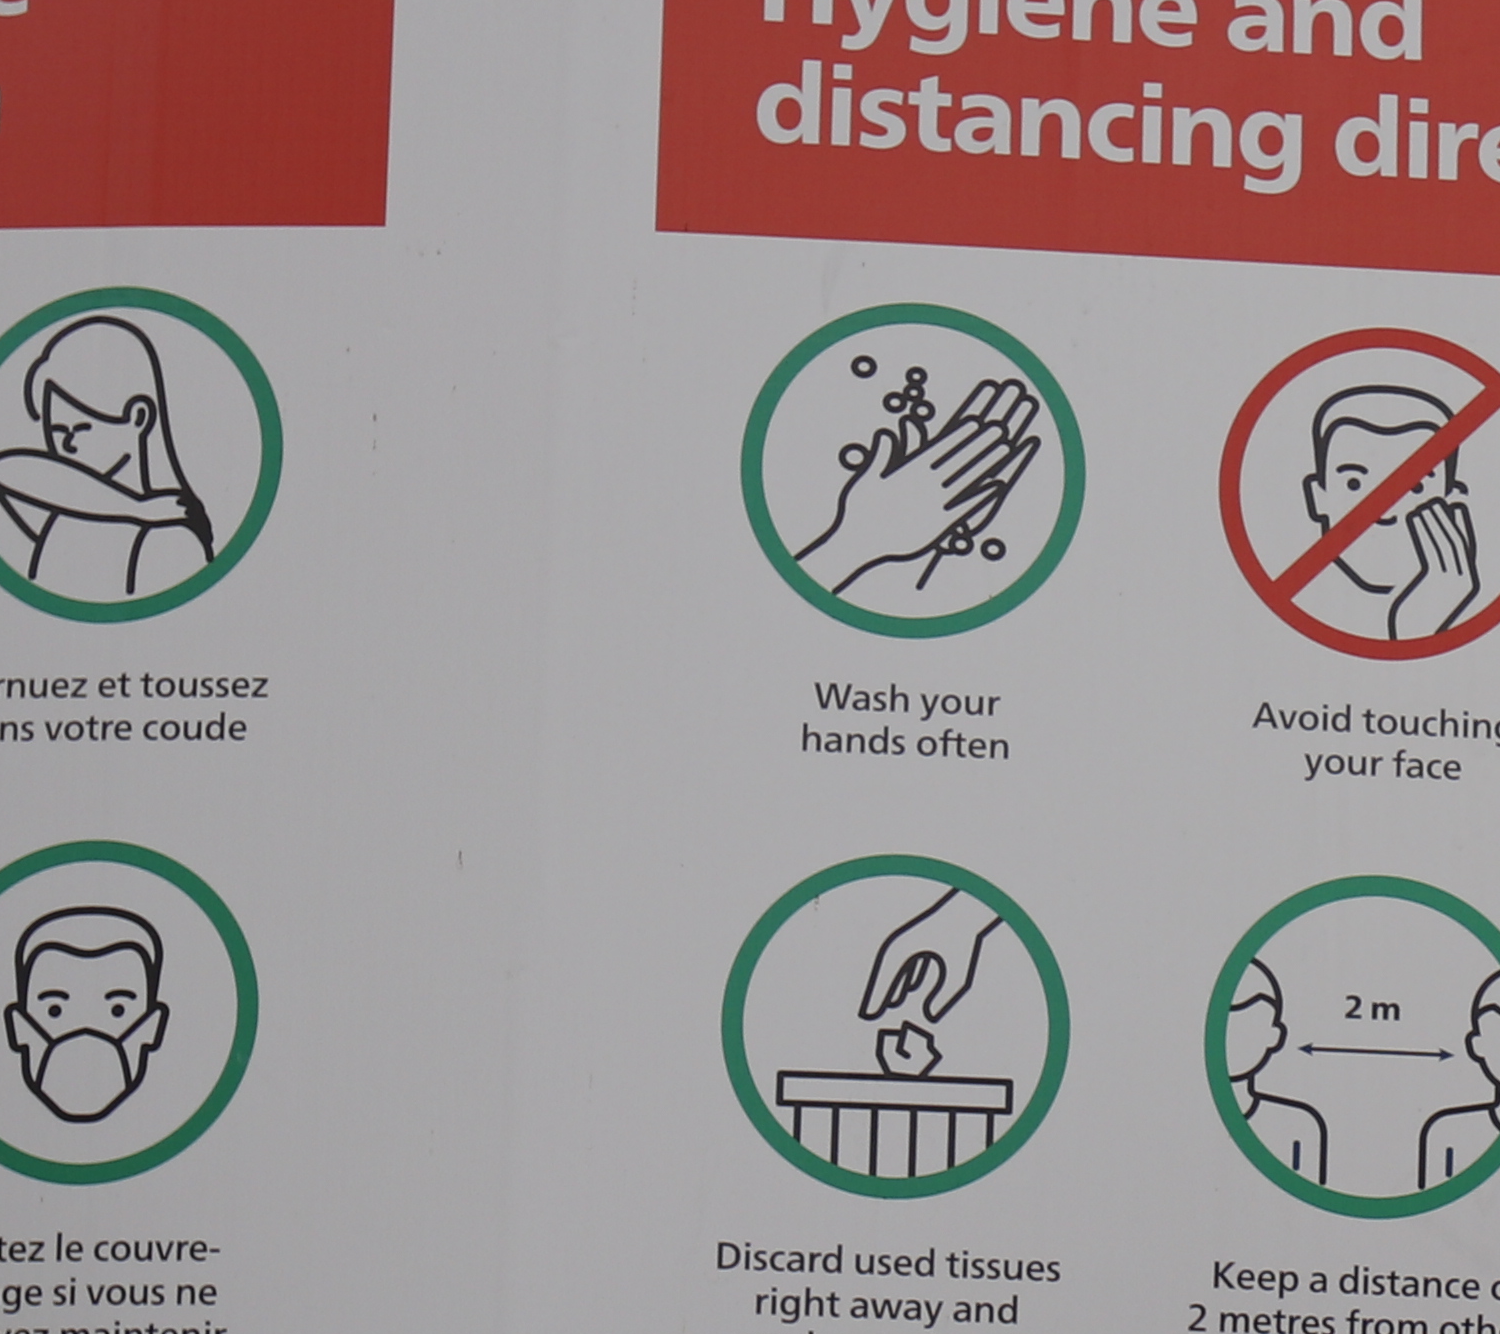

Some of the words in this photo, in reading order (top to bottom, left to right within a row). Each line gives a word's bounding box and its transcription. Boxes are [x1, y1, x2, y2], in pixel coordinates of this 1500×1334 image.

[755, 58, 1304, 196] distancing
[97, 672, 132, 699] et
[139, 672, 269, 699] toussez
[813, 681, 910, 714] Wash
[919, 692, 1002, 723] your
[43, 715, 134, 742] votre
[141, 710, 248, 742] coude
[1251, 701, 1352, 734] Avoid
[801, 721, 907, 757] hands
[915, 727, 1010, 761] often
[1303, 752, 1385, 783] your
[1391, 748, 1463, 782] face
[1343, 993, 1363, 1021] 2
[1370, 1001, 1401, 1022] m
[55, 1231, 85, 1263] le
[92, 1239, 221, 1263] couvre-
[716, 1240, 844, 1275] Discard
[854, 1246, 936, 1278] used
[944, 1249, 1062, 1284] tissues
[52, 1276, 77, 1307] si
[85, 1283, 166, 1307] vous
[175, 1283, 218, 1307] ne
[1212, 1260, 1300, 1300] Keep
[1308, 1271, 1329, 1294] a
[1337, 1264, 1481, 1301] distance
[754, 1286, 841, 1325] right
[848, 1296, 944, 1330] away
[952, 1293, 1019, 1326] and
[1187, 1302, 1208, 1333] 2
